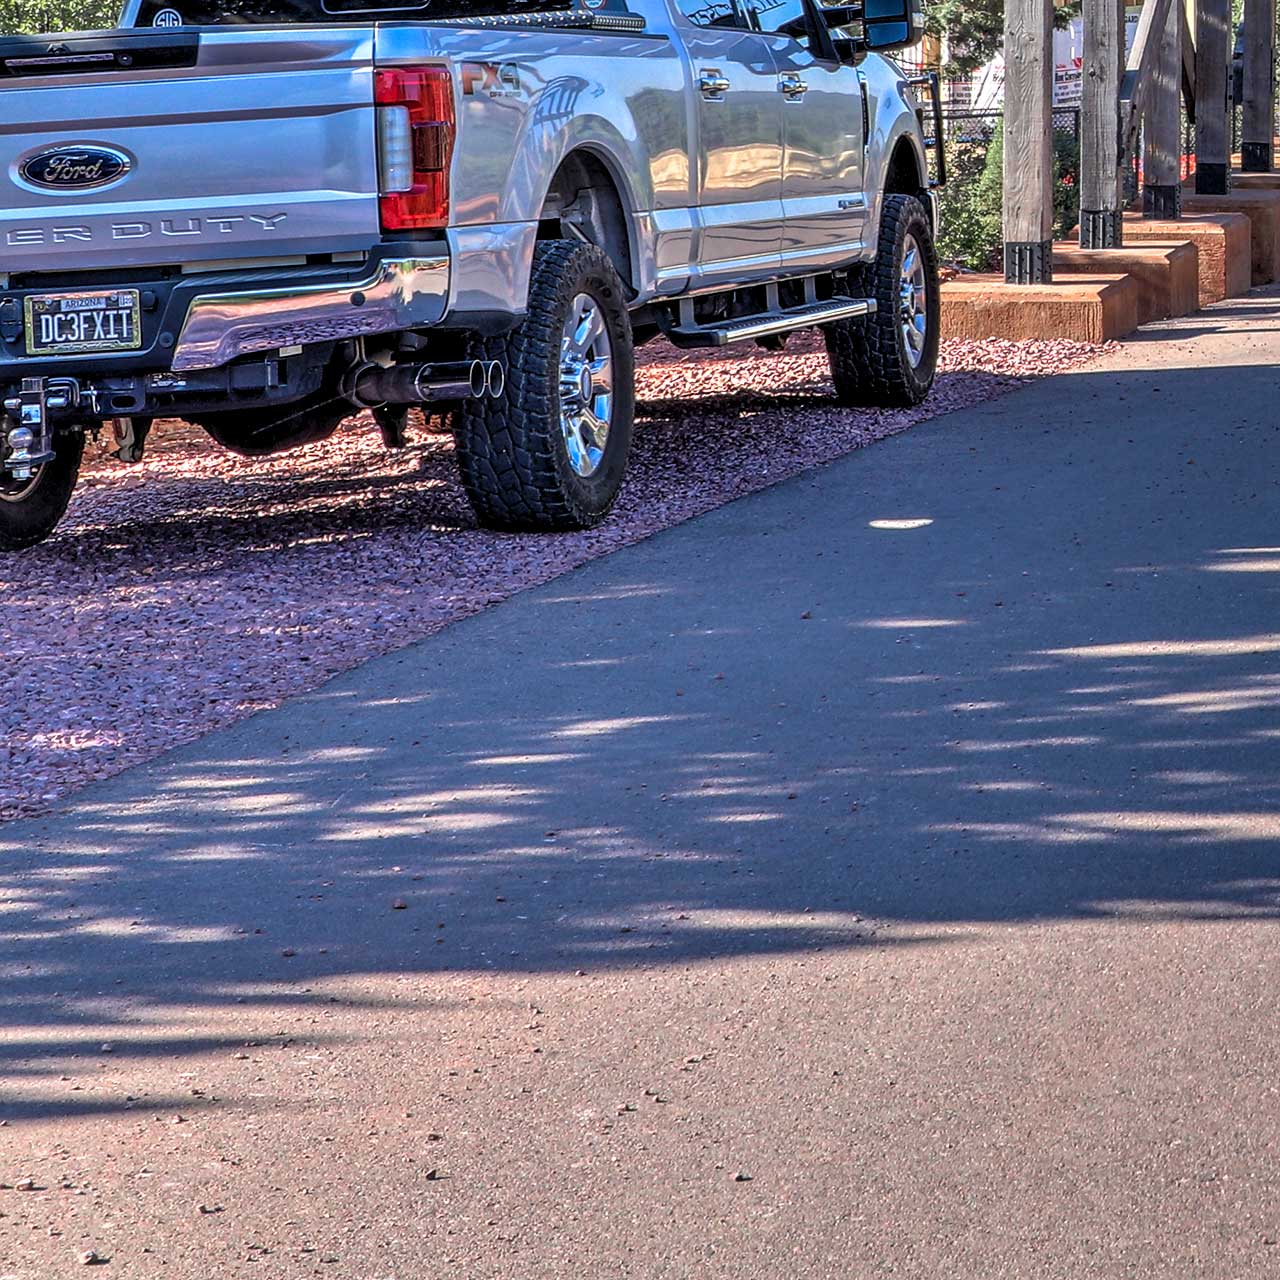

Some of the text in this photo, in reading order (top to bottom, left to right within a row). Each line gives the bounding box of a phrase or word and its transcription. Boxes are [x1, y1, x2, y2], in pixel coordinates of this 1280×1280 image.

[156, 12, 179, 28] SIG
[462, 61, 520, 95] FX4
[43, 154, 104, 181] Ford
[112, 212, 287, 240] DUTY
[65, 298, 101, 309] ARIZONA
[40, 309, 131, 344] DC3FXIT
